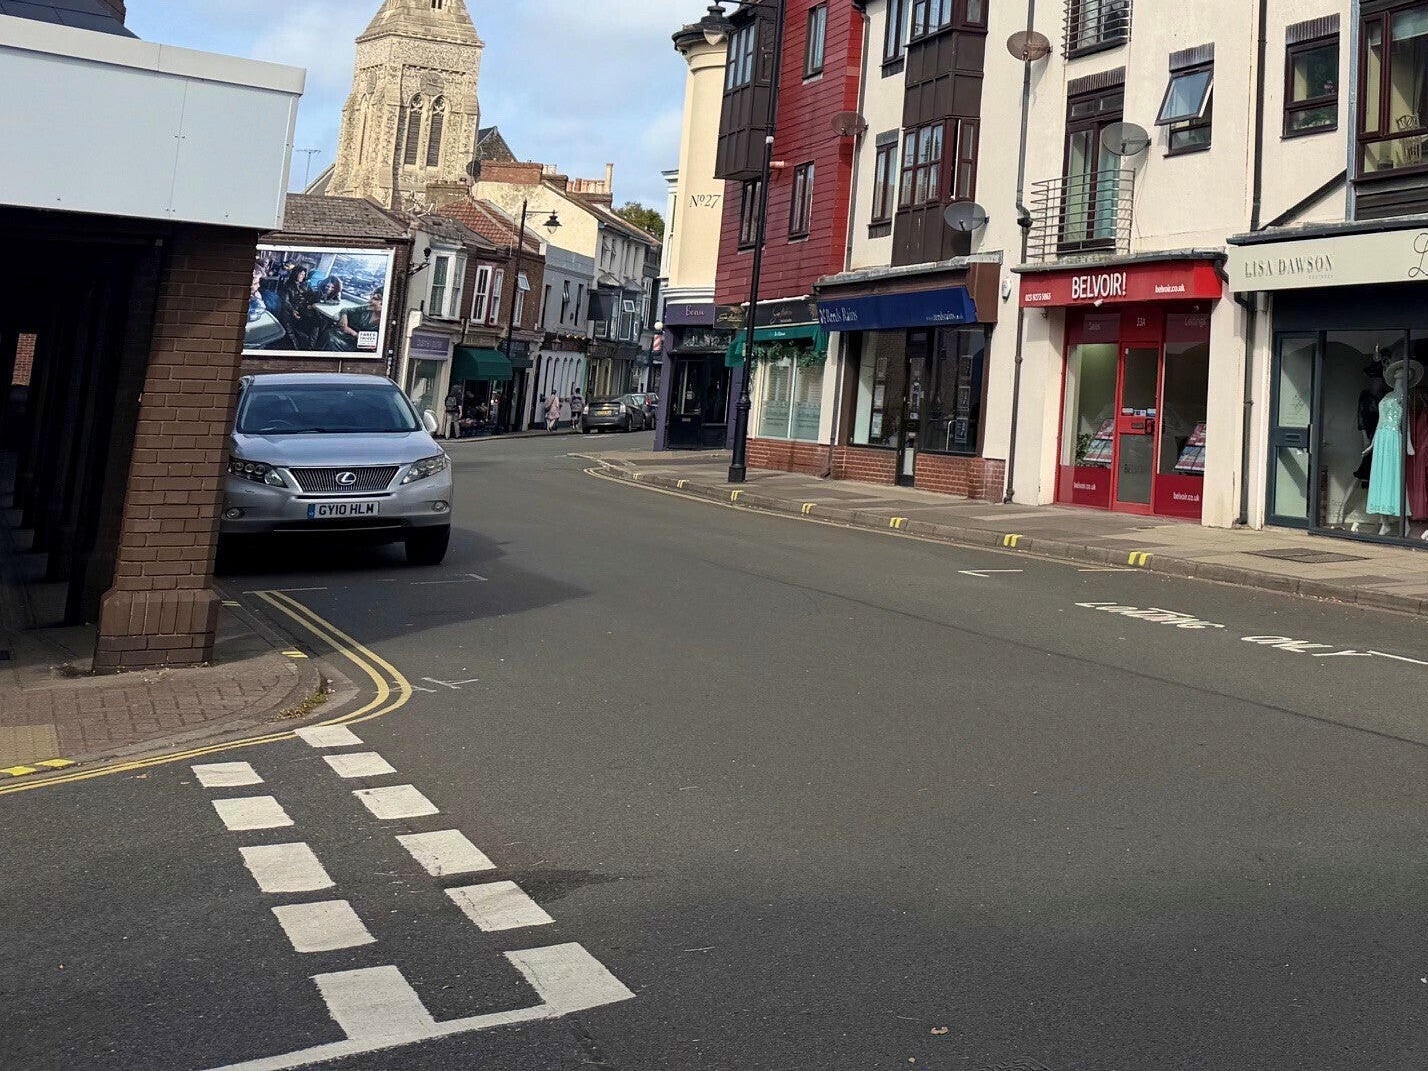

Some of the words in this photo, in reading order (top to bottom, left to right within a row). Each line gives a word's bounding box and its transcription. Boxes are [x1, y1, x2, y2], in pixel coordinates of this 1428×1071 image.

[1245, 260, 1273, 278] LISA
[1278, 254, 1333, 276] DAWSON
[1071, 271, 1127, 300] BELVOIR!
[318, 504, 347, 516] GY10
[350, 503, 374, 515] HLM
